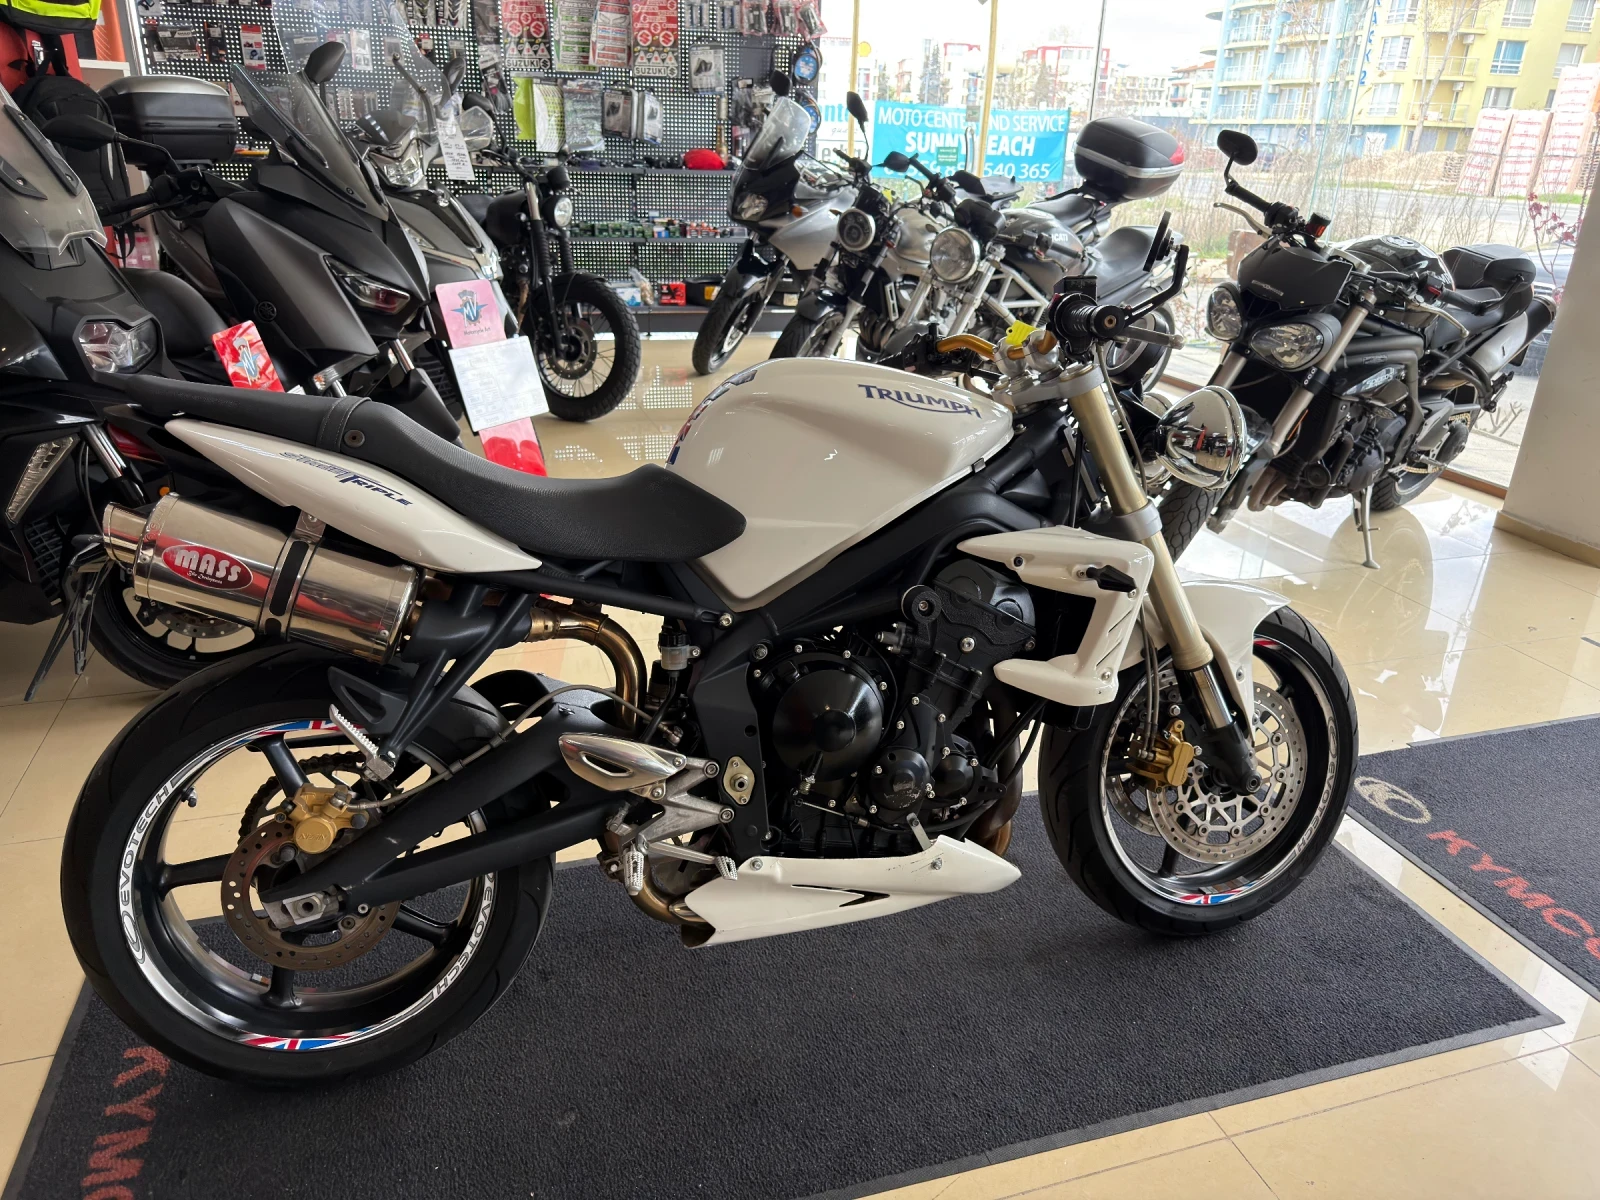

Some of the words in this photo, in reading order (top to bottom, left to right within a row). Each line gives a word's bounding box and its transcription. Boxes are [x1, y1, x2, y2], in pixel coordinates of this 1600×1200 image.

[506, 58, 539, 68] SUZUKI
[634, 66, 667, 76] SUZUKI
[877, 106, 923, 126] MOTO
[1013, 114, 1066, 133] SERVICE
[984, 134, 1036, 158] EACH
[1018, 163, 1051, 180] 365
[858, 383, 982, 419] TRIUMPH
[338, 474, 414, 507] TRIPLE
[174, 549, 242, 583] MASS
[1296, 760, 1336, 853] EVOTECH
[119, 785, 170, 907] EVOTECH
[435, 885, 494, 996] EVOTECH
